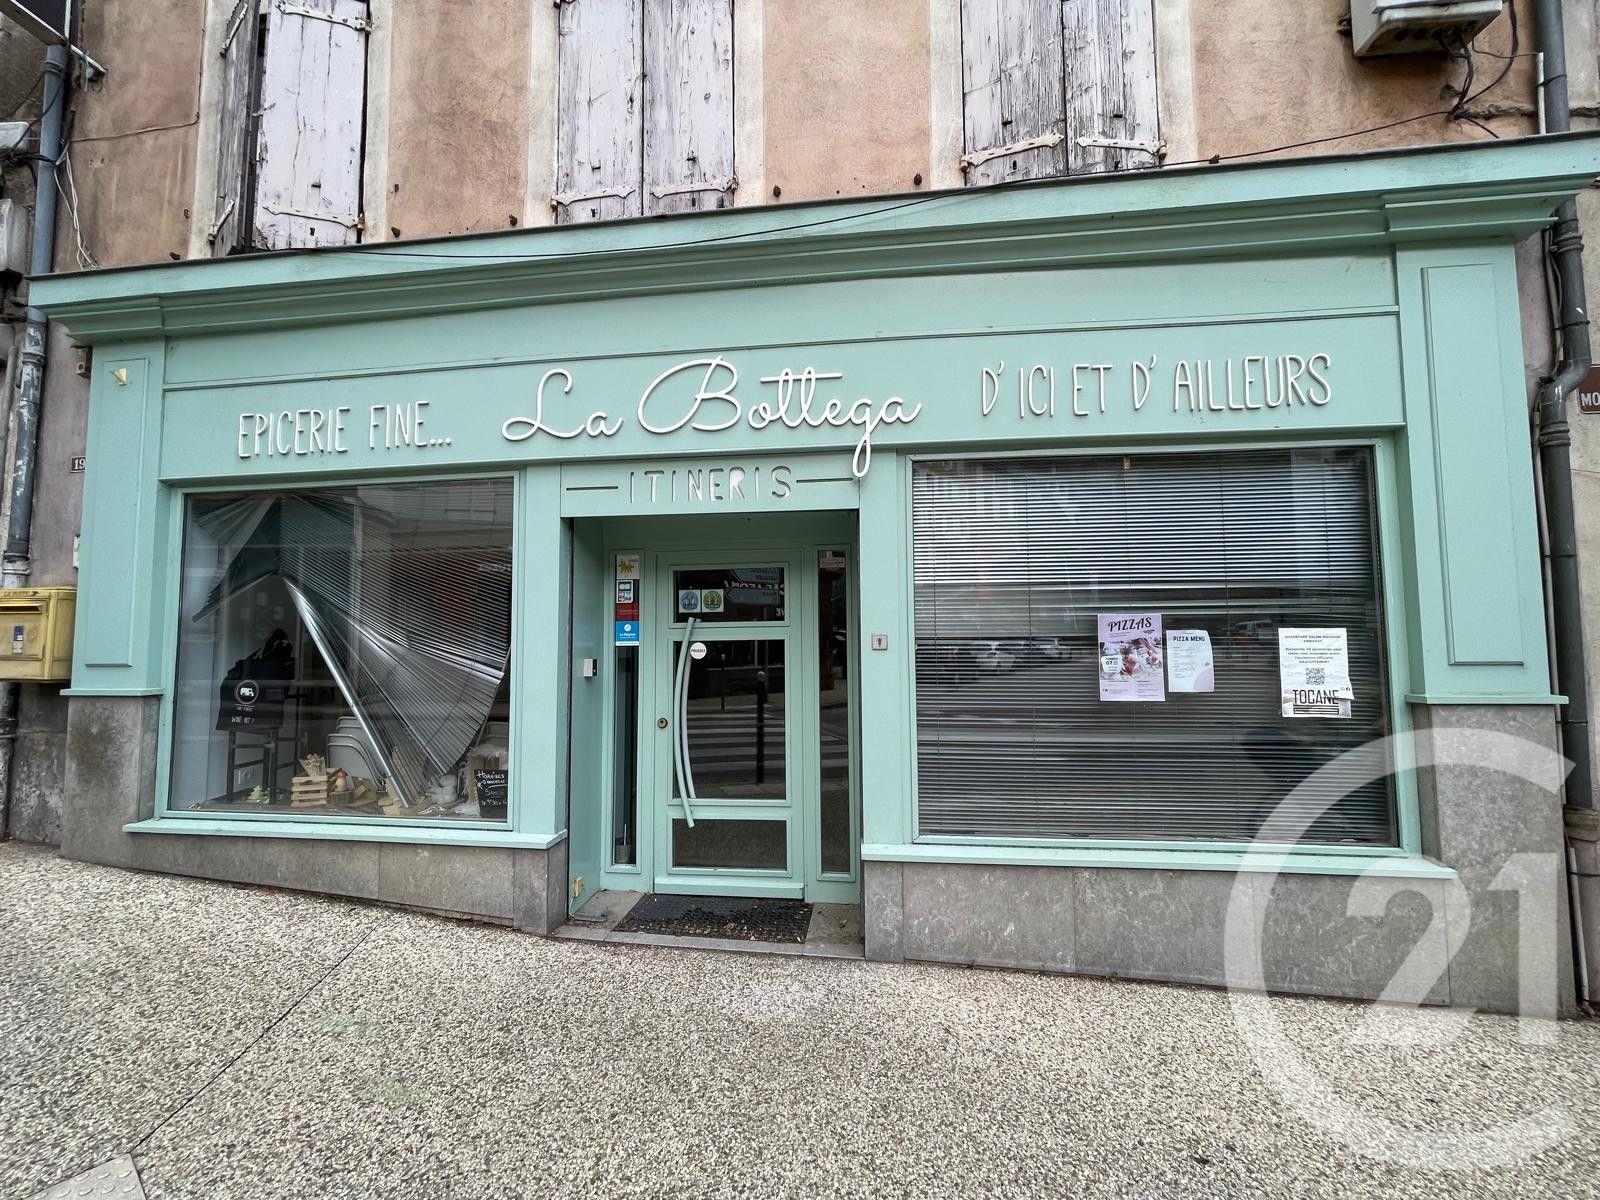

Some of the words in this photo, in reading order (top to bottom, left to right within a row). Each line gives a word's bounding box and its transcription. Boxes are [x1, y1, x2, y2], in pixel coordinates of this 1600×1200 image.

[1072, 363, 1113, 416] ET
[1173, 352, 1332, 413] AILLEURS
[238, 406, 351, 459] EPICERIE
[501, 368, 623, 441] La
[637, 355, 922, 478] Bottega
[74, 458, 86, 470] 19
[628, 465, 793, 504] ITINERIS
[1108, 617, 1152, 631] PIZZAS
[1292, 689, 1339, 704] TOCANE
